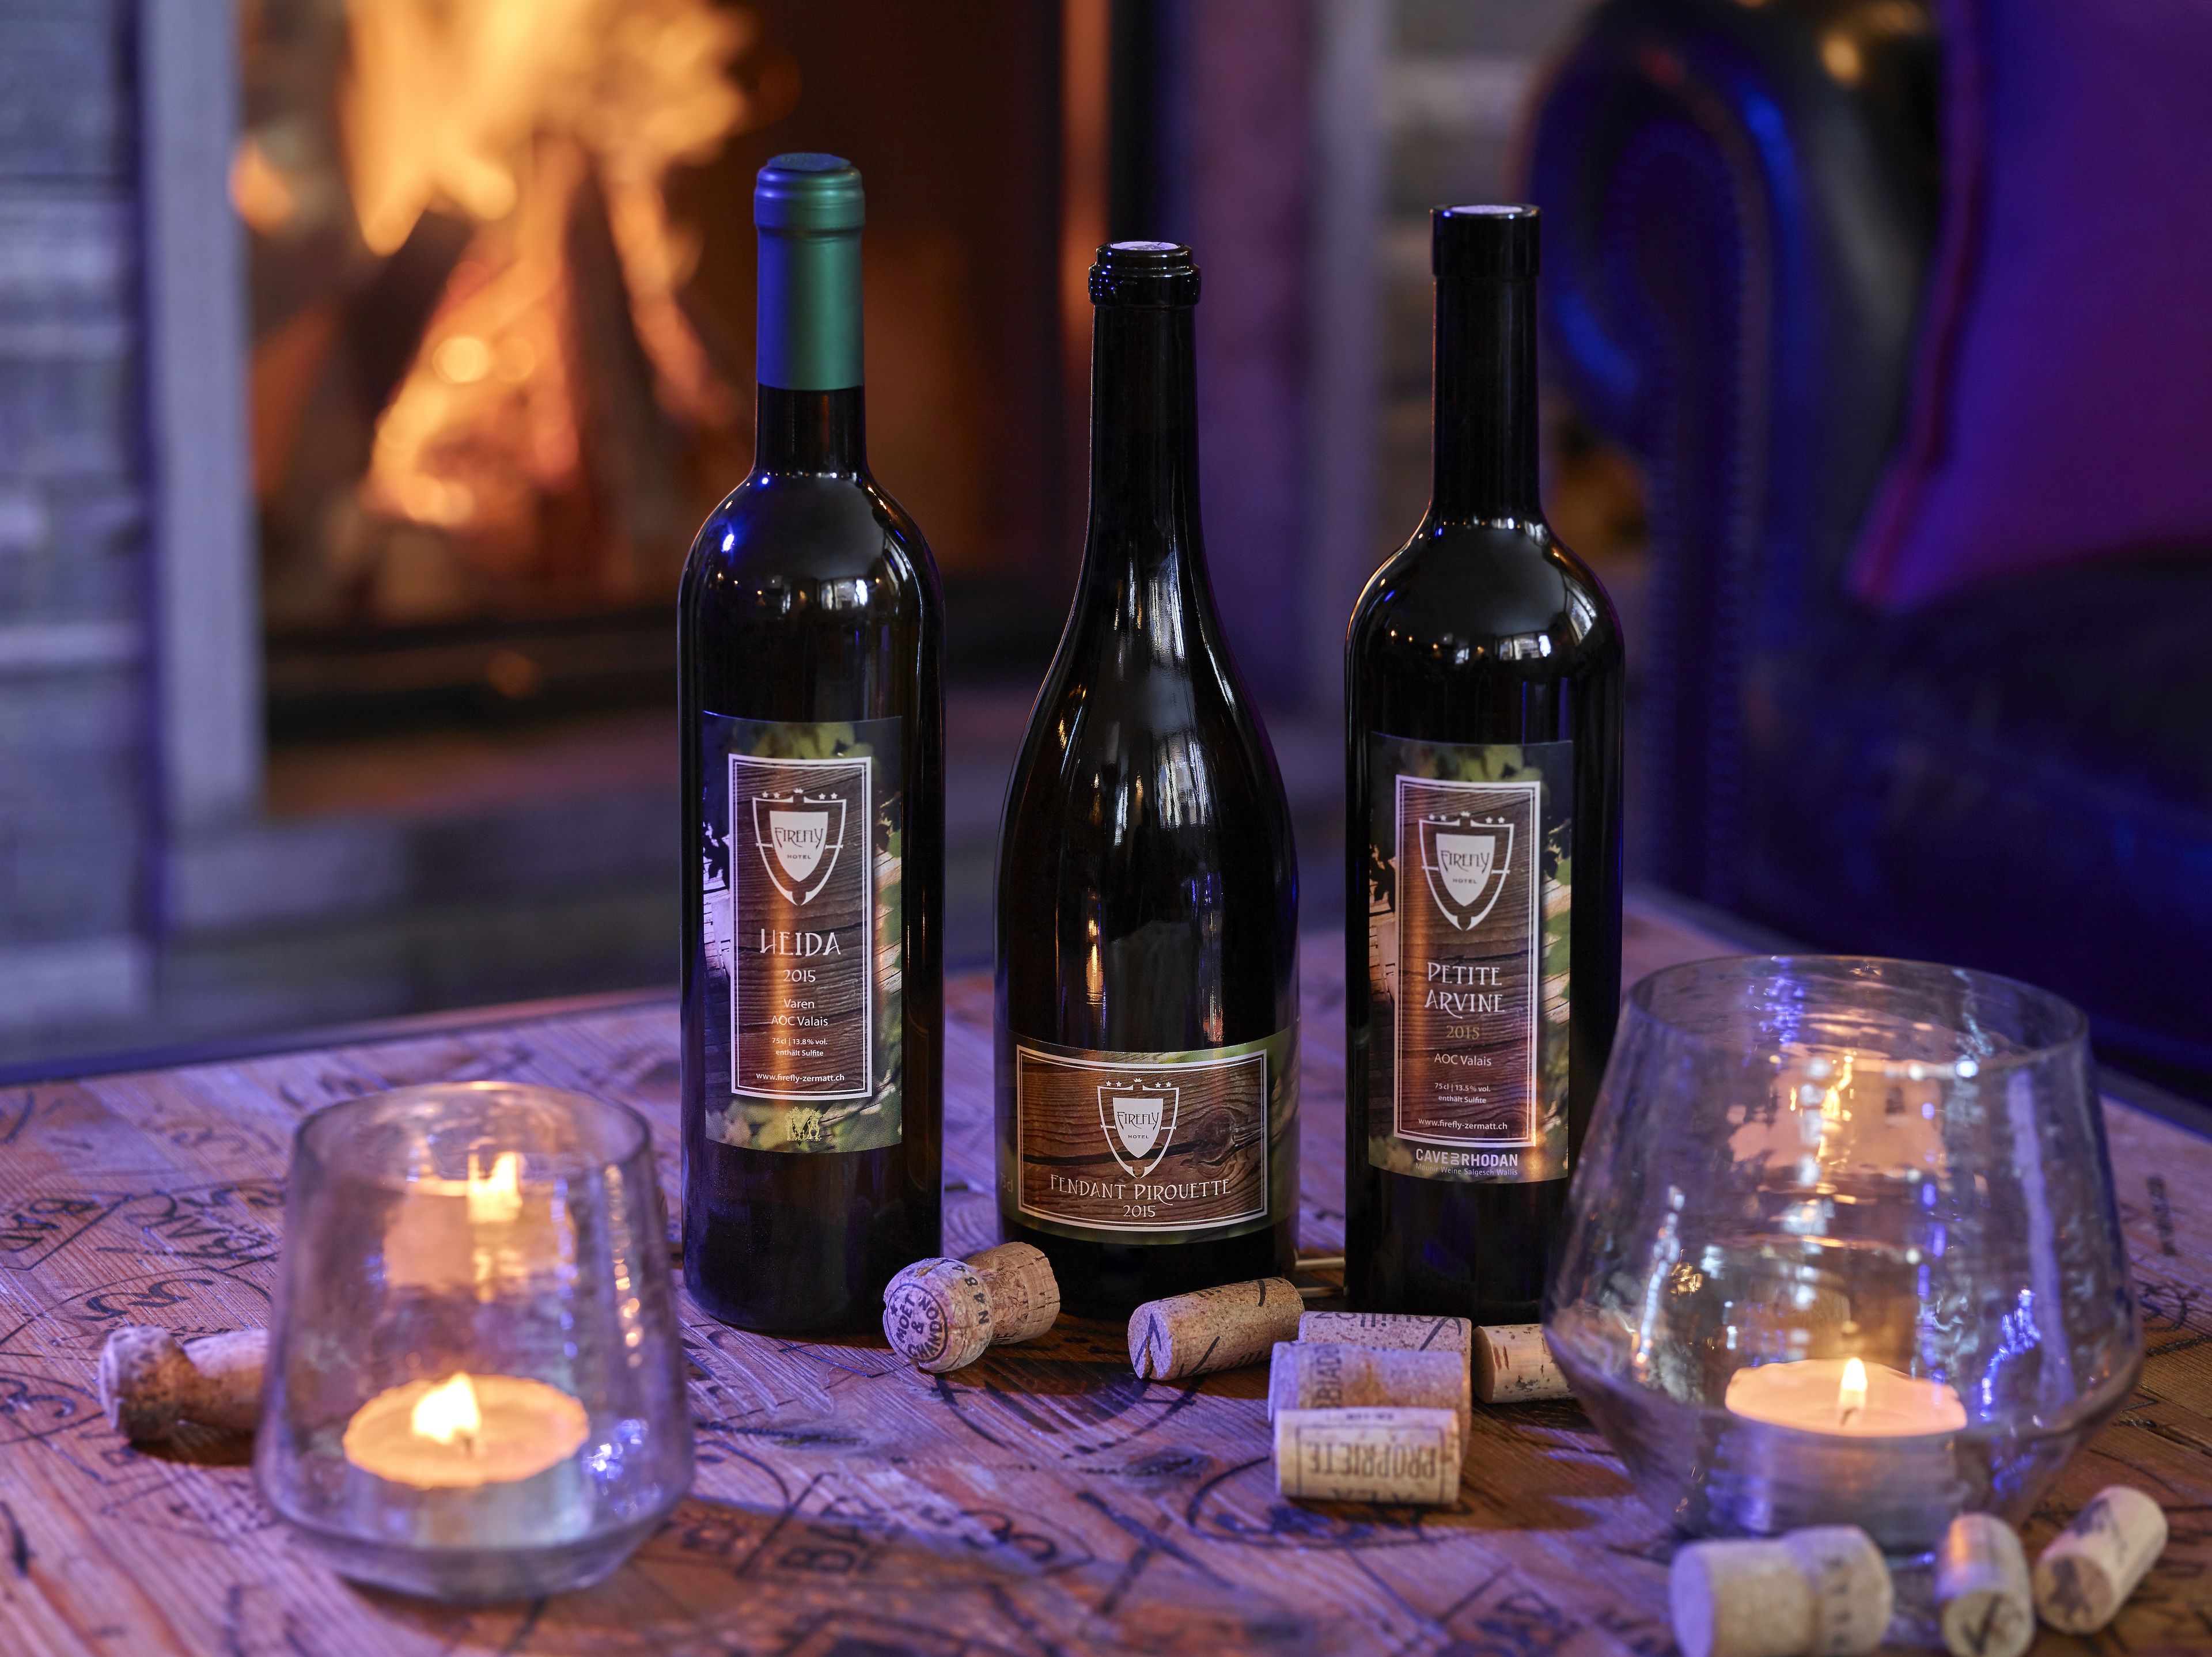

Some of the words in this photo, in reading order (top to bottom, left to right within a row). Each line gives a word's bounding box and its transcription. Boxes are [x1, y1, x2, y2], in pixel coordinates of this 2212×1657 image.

[774, 826, 824, 850] FIREFLY
[1440, 850, 1490, 874] FIREFLY
[759, 928, 842, 957] HEIDA
[782, 969, 816, 983] 2015
[1427, 961, 1503, 986] PETITE
[783, 998, 815, 1009] Varen
[1424, 989, 1506, 1019] ARVINE
[771, 1015, 796, 1026] AOC
[797, 1015, 829, 1027] Valais
[1446, 1025, 1480, 1040] 2015
[1434, 1052, 1459, 1065] AOC
[1460, 1055, 1492, 1066] Valais
[756, 1072, 846, 1084] www.firefly-zermatt.ch
[1116, 1111, 1160, 1131] FIREFLY
[1418, 1118, 1508, 1130] www.firefly-zermatt.ch
[1415, 1148, 1449, 1165] CAVE
[1460, 1153, 1518, 1167] RHODAN
[1415, 1162, 1439, 1173] Mounir
[1441, 1166, 1462, 1175] Weine
[1464, 1168, 1494, 1177] Salgesch
[1050, 1173, 1126, 1200] FENDANT
[1134, 1178, 1232, 1206] PIROUETTE
[1122, 1204, 1156, 1218] 2015
[907, 1295, 942, 1358] CHANDON
[911, 1321, 925, 1334] &
